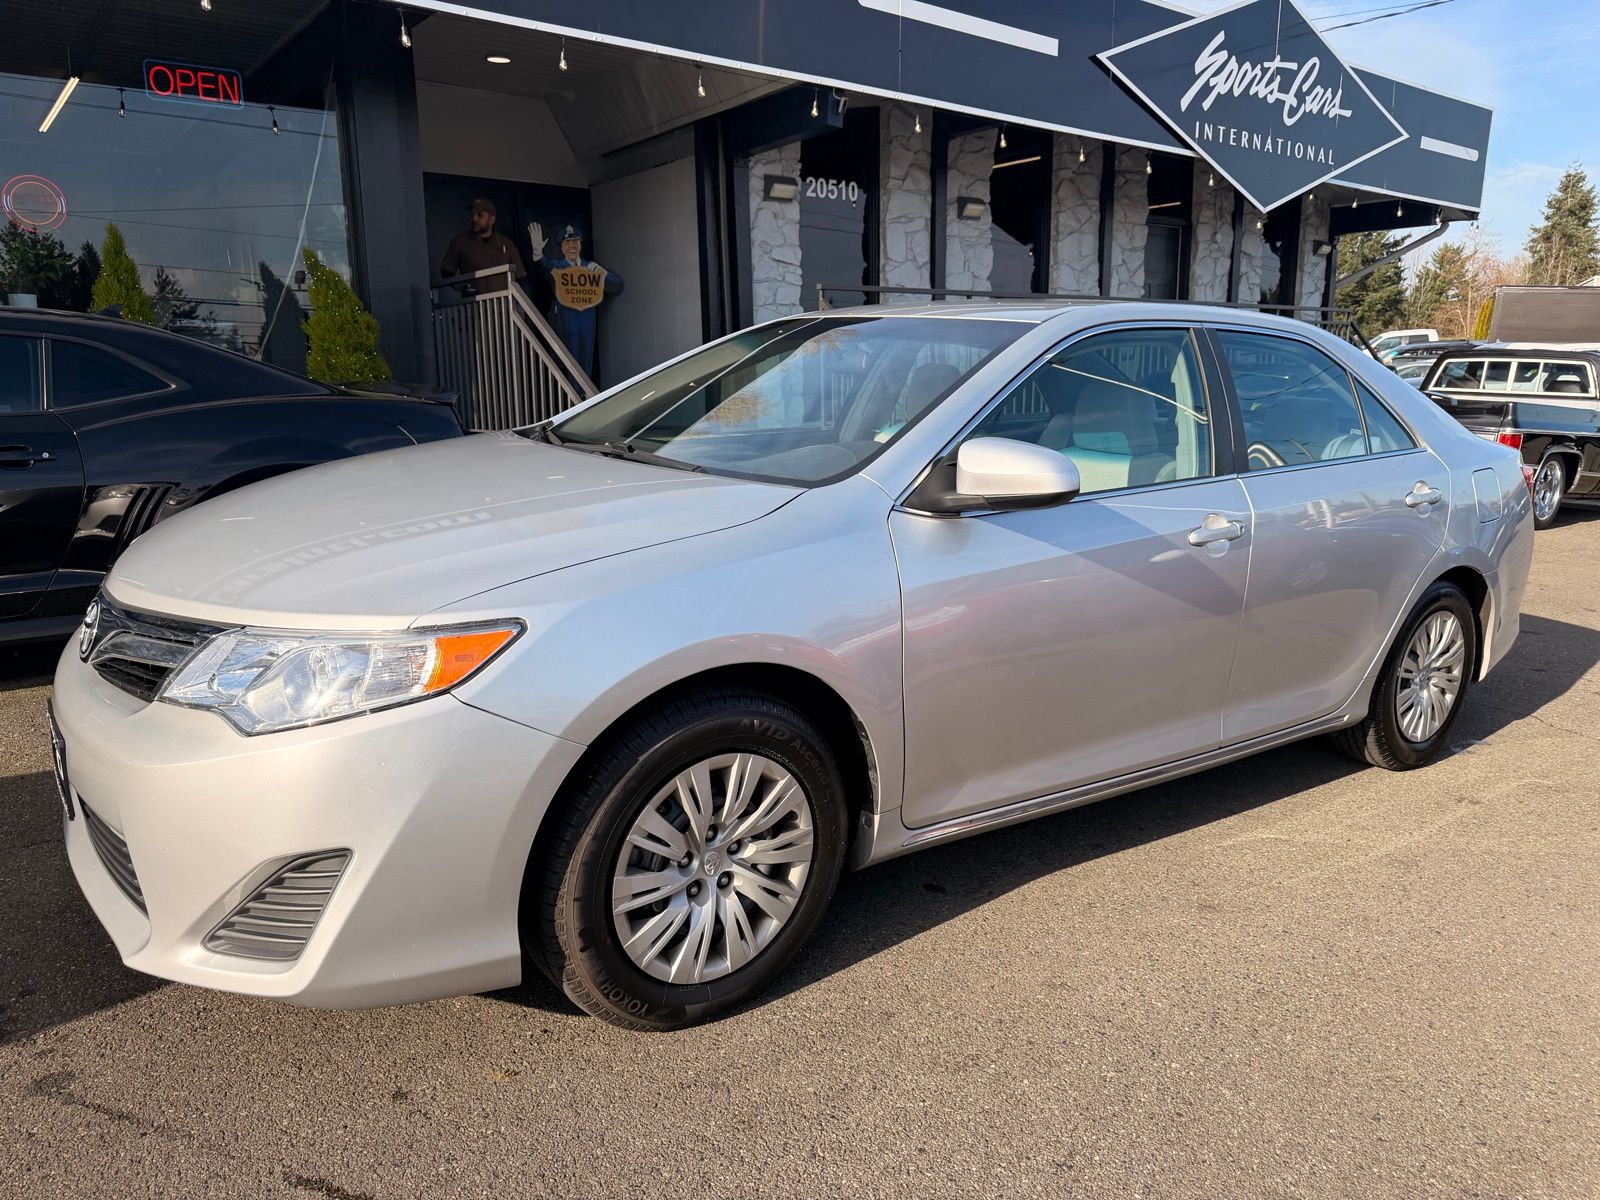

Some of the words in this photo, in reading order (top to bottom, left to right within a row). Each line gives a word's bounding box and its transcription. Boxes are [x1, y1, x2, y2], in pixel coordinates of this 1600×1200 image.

[149, 65, 240, 105] OPEN
[1180, 30, 1298, 112] Sports
[1283, 57, 1352, 126] Cars
[1195, 121, 1335, 165] INTERNATIONAL
[805, 176, 858, 202] 20510
[561, 272, 601, 288] SLOW
[564, 288, 599, 296] SCHOOL
[570, 296, 593, 304] ZONE
